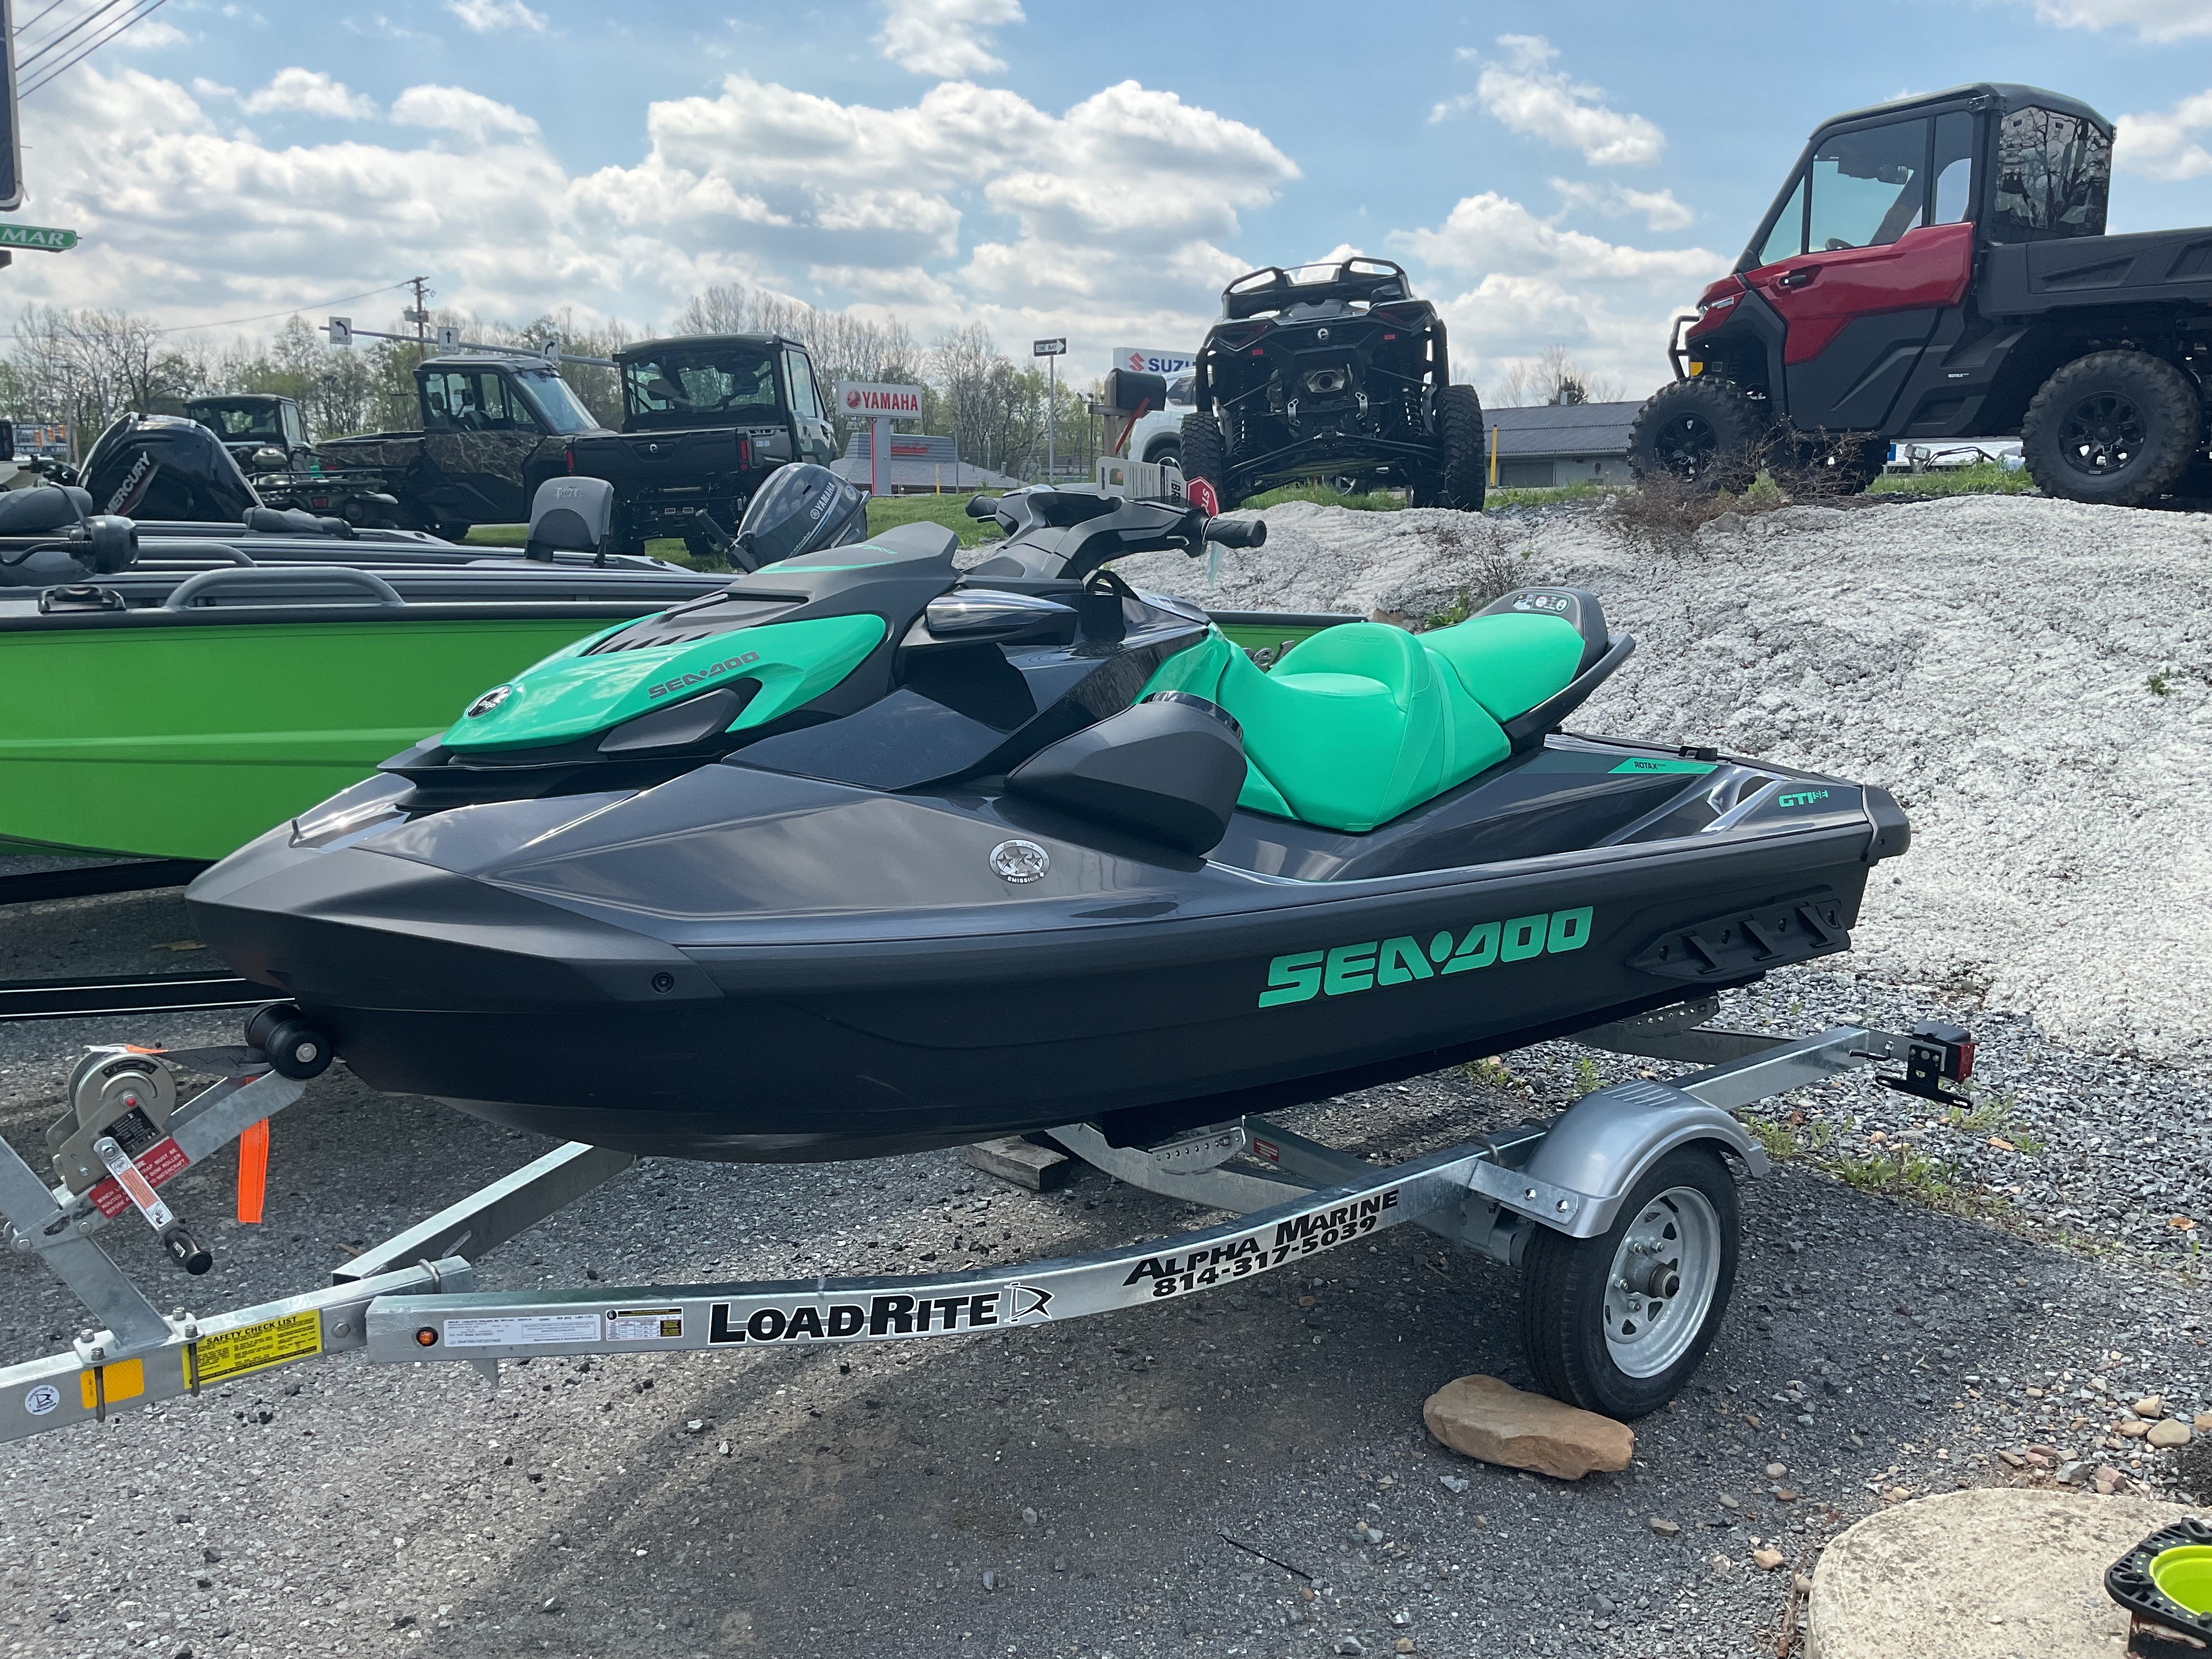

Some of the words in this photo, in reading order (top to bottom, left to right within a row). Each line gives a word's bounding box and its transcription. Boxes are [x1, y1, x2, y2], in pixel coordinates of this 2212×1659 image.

[1, 228, 64, 245] MAR
[1148, 358, 1196, 373] SUZ
[862, 391, 918, 411] YAMAHA
[103, 451, 150, 515] MERCURY
[815, 482, 836, 511] YAMAHA
[478, 700, 496, 709] BRP
[1634, 761, 1658, 770] ROTAX
[1779, 792, 1814, 807] GTI
[1007, 875, 1039, 883] EMISSION
[97, 1190, 114, 1203] WINCH
[140, 1164, 153, 1175] TRAP
[154, 1153, 168, 1165] MUST
[101, 1194, 122, 1209] ROUTED
[150, 1166, 162, 1176] BOW
[162, 1153, 182, 1168] ROLLER
[106, 1200, 125, 1215] BEFORE
[156, 1158, 185, 1181] WATERCRAFT
[1122, 1237, 1261, 1286] ALPHA
[1274, 1189, 1399, 1246] MARINE
[1152, 1216, 1378, 1297] 814-317-5039
[206, 1330, 242, 1345] SAFETY
[245, 1321, 275, 1335] CHECK
[278, 1316, 297, 1326] LIST
